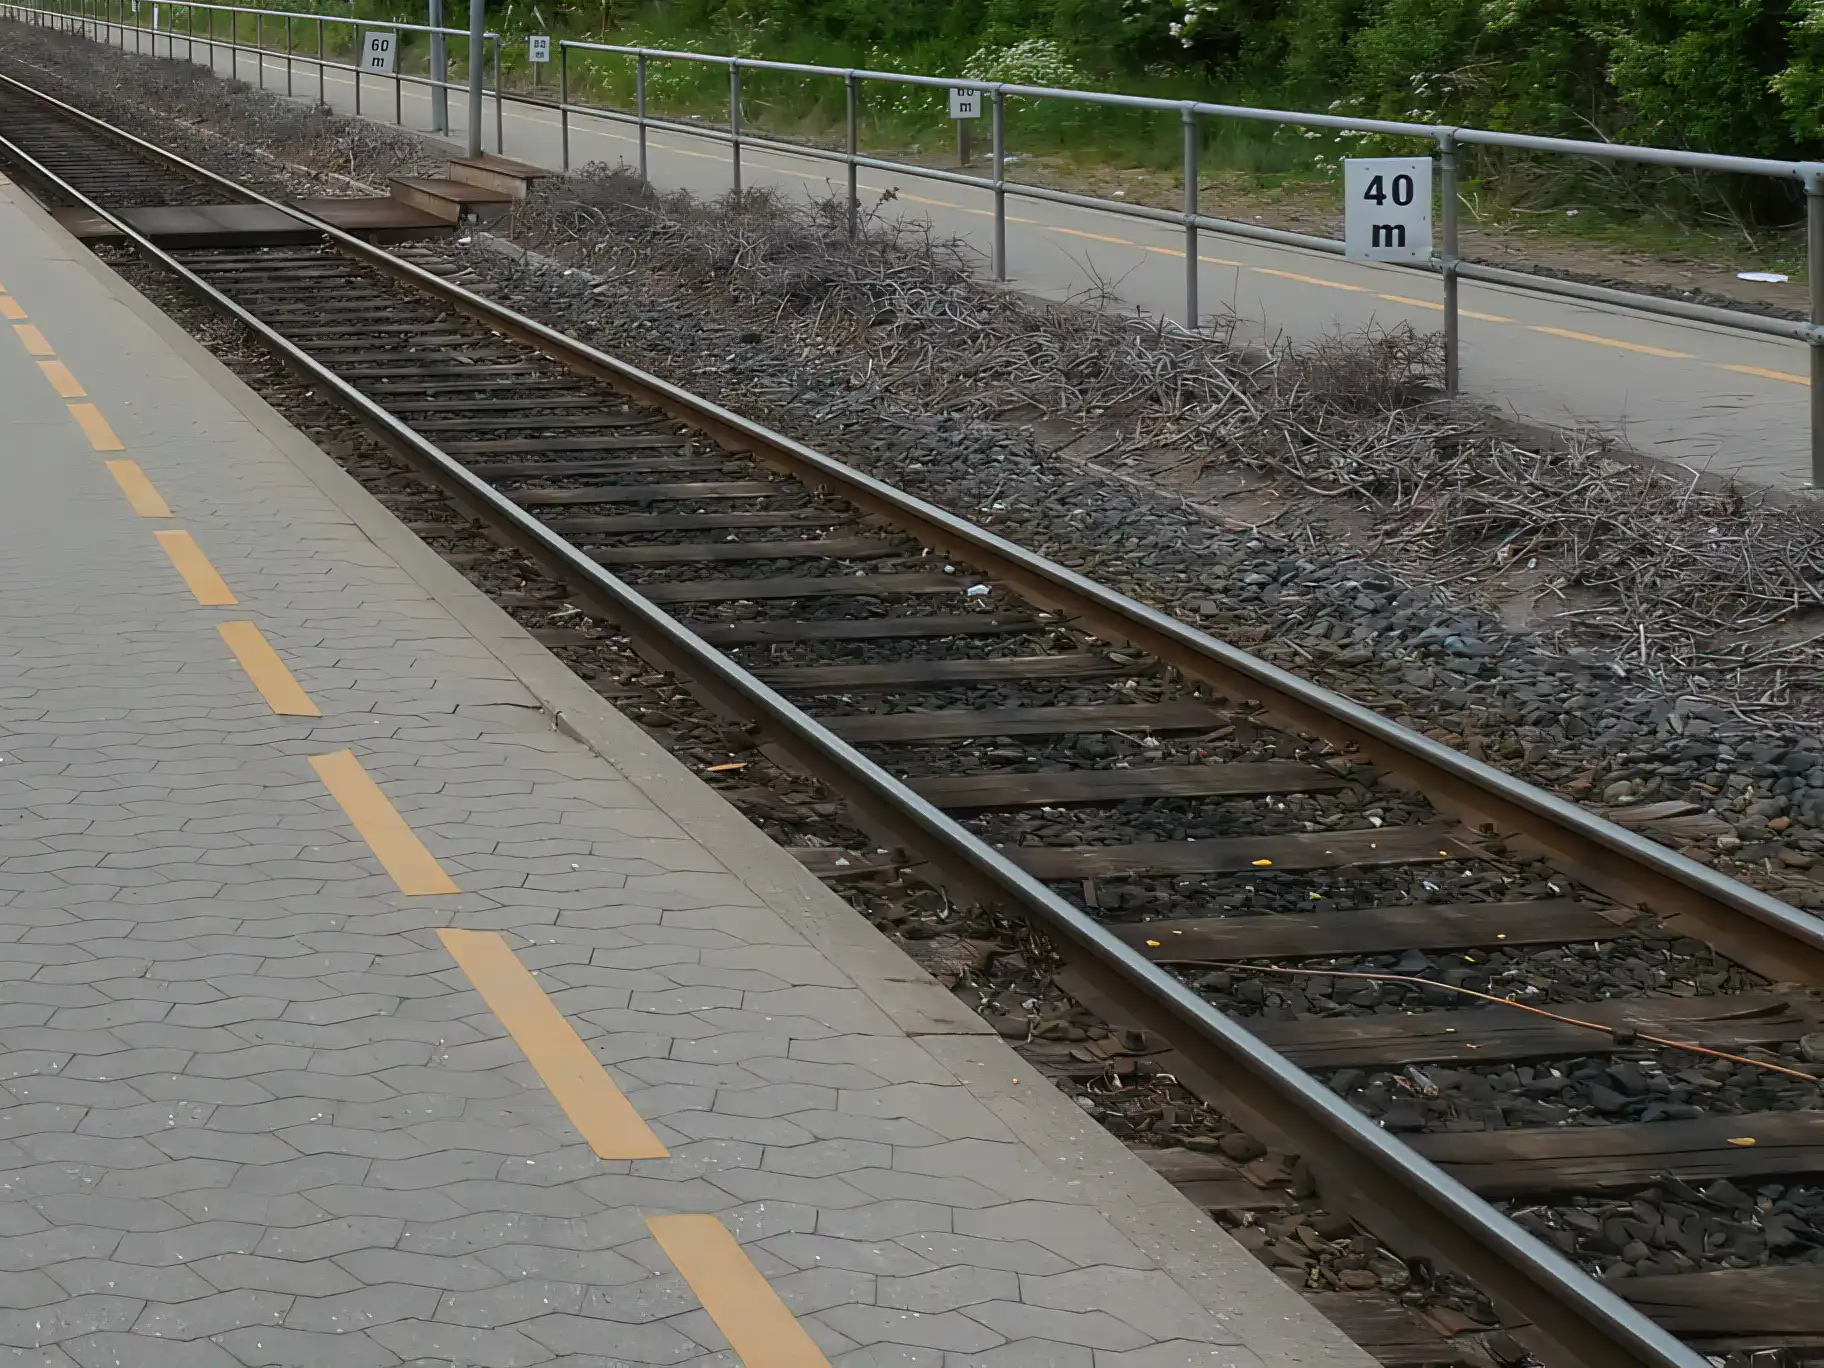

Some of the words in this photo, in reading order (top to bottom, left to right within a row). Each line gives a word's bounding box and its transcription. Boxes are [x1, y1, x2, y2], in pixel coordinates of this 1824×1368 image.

[371, 38, 389, 51] 60
[371, 57, 384, 67] m
[959, 102, 971, 112] m
[1363, 174, 1414, 206] 40
[1371, 224, 1406, 248] m
